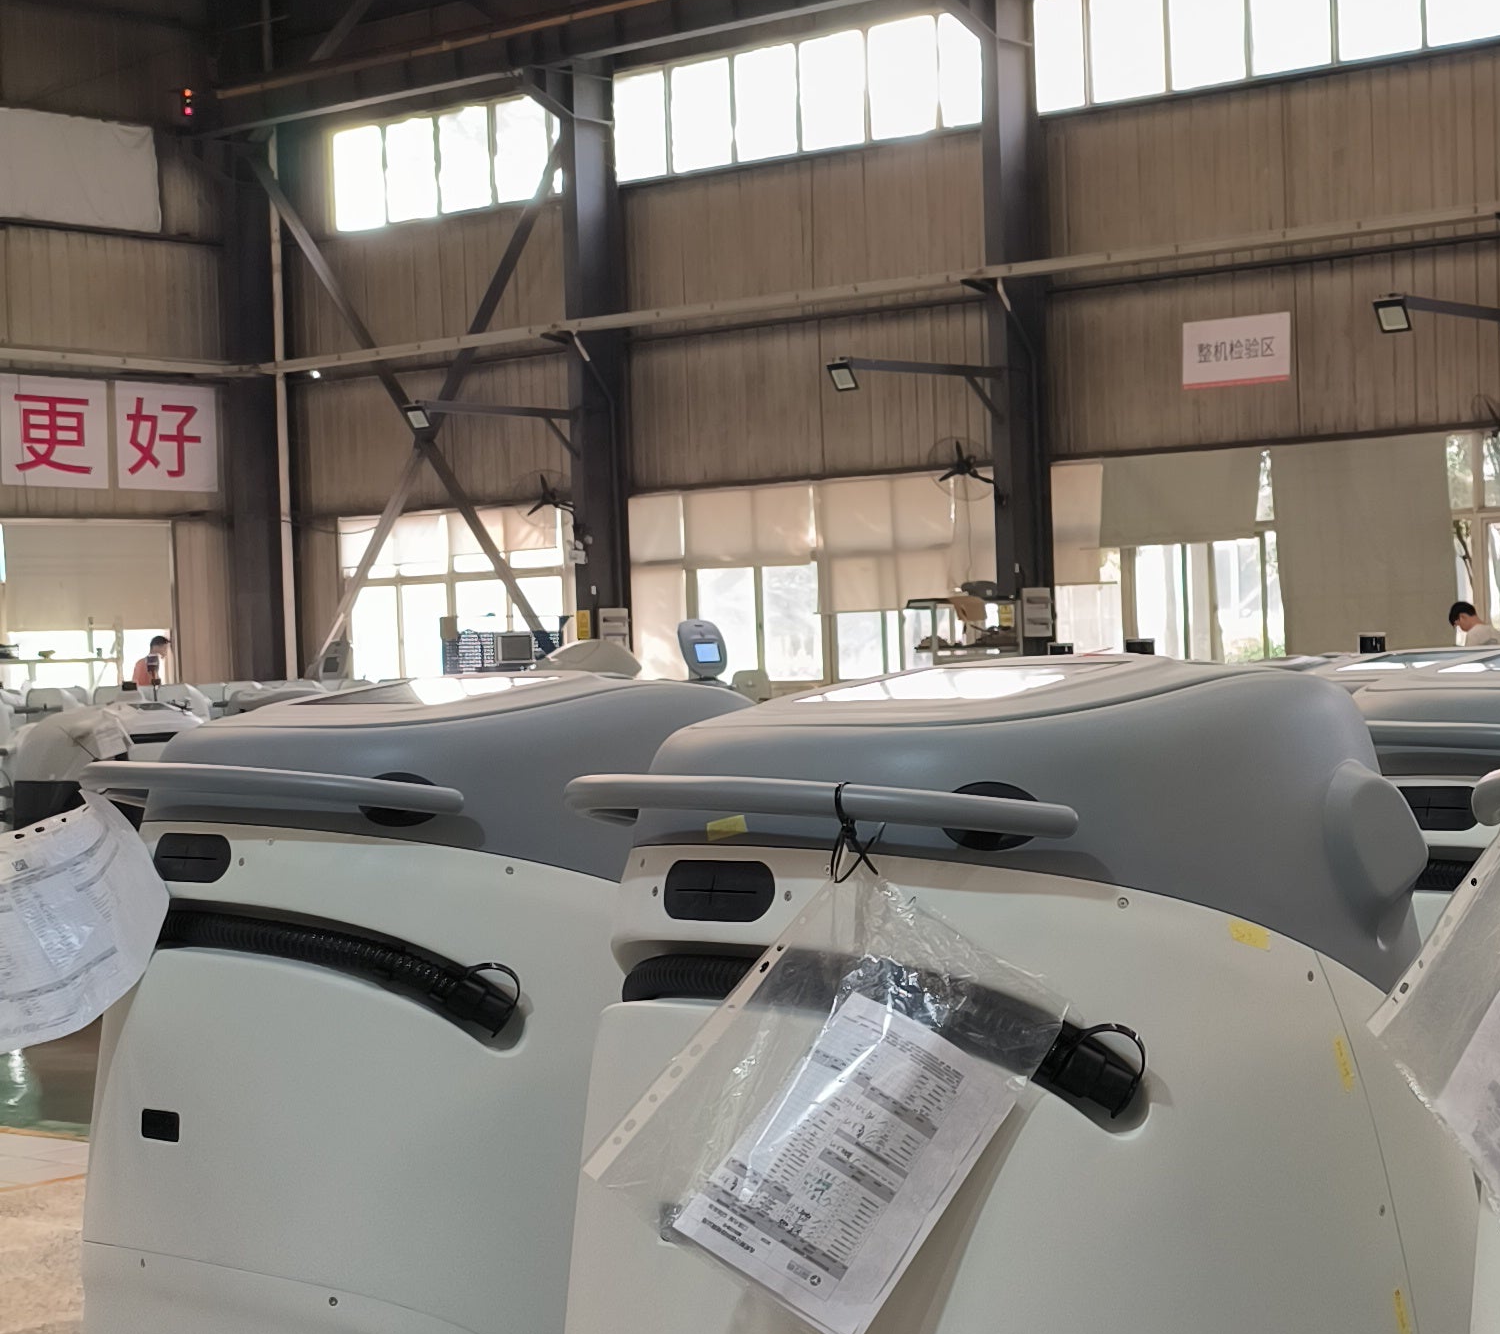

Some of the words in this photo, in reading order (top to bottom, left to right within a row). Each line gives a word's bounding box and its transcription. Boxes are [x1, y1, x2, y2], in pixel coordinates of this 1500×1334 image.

[1197, 336, 1275, 363] 整机检验区
[14, 393, 201, 478] 更好
